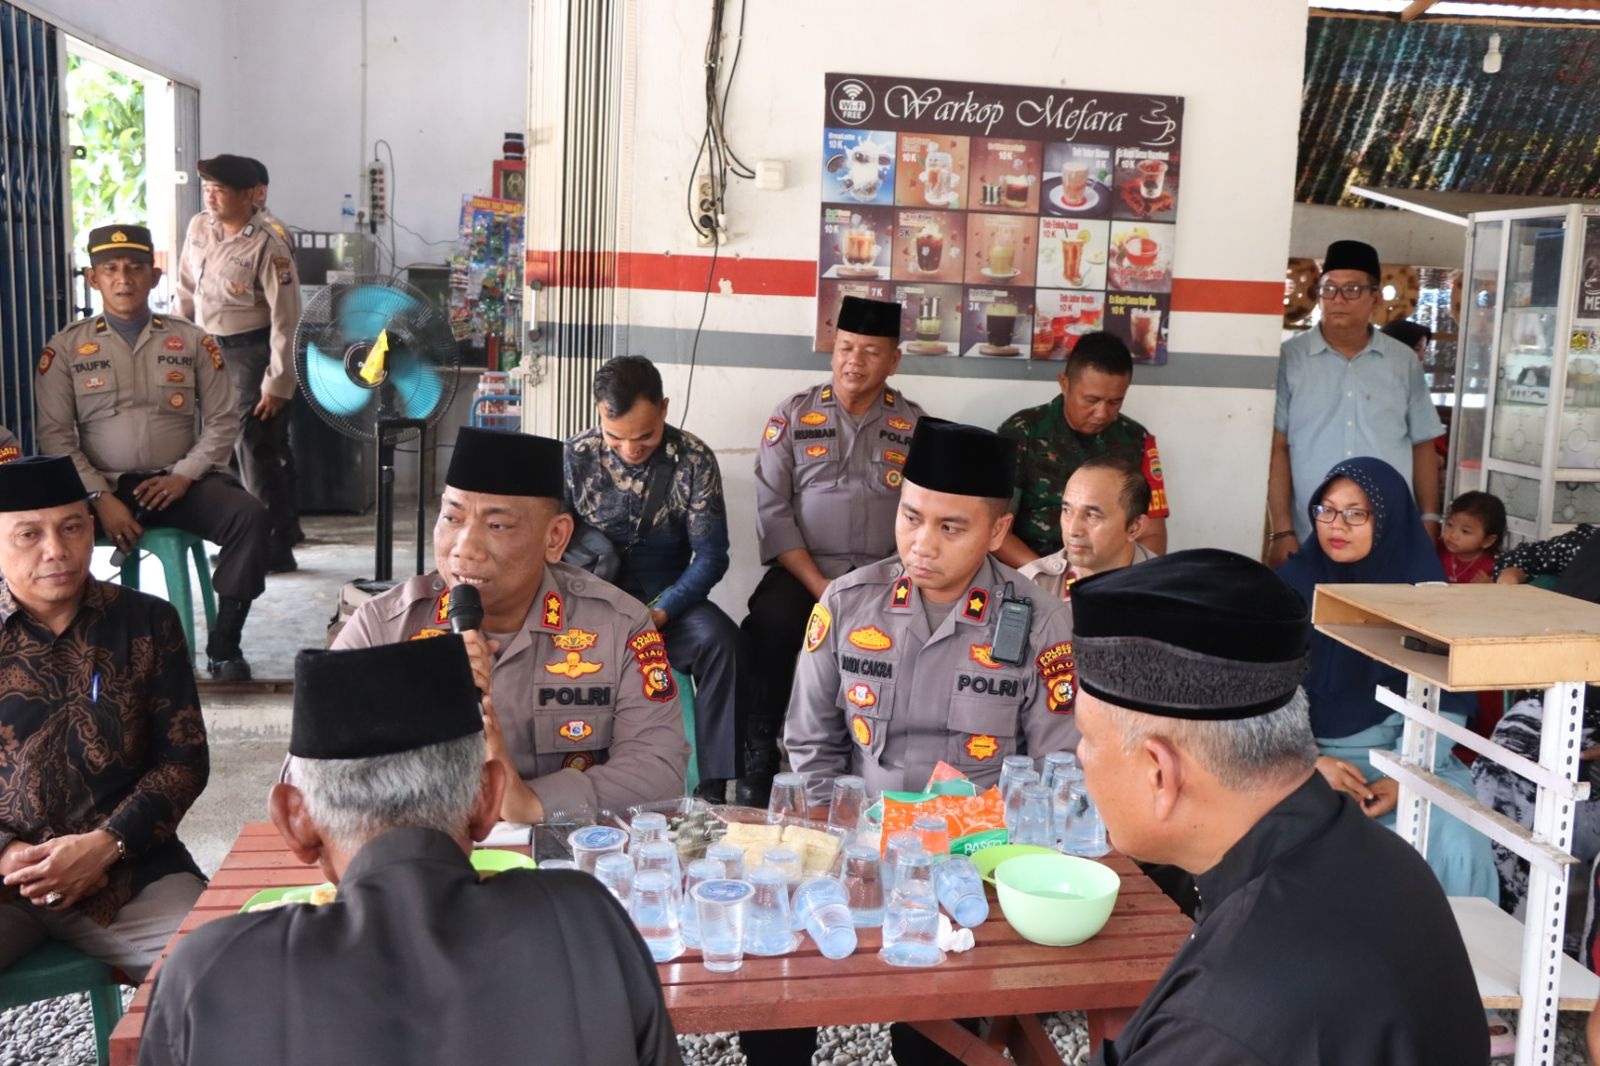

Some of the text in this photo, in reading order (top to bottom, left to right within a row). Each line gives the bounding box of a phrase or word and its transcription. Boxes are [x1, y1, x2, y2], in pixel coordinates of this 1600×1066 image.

[843, 110, 862, 119] FREE
[884, 85, 1128, 141] Warkop Mefara
[72, 359, 112, 373] TAUFIK
[157, 355, 193, 367] POLRI
[879, 429, 912, 446] POLR
[638, 650, 663, 660] RIAU
[861, 659, 892, 679] CAKRA
[1043, 662, 1074, 676] RIAU
[958, 674, 1018, 697] POLRI
[539, 687, 611, 706] POLRI
